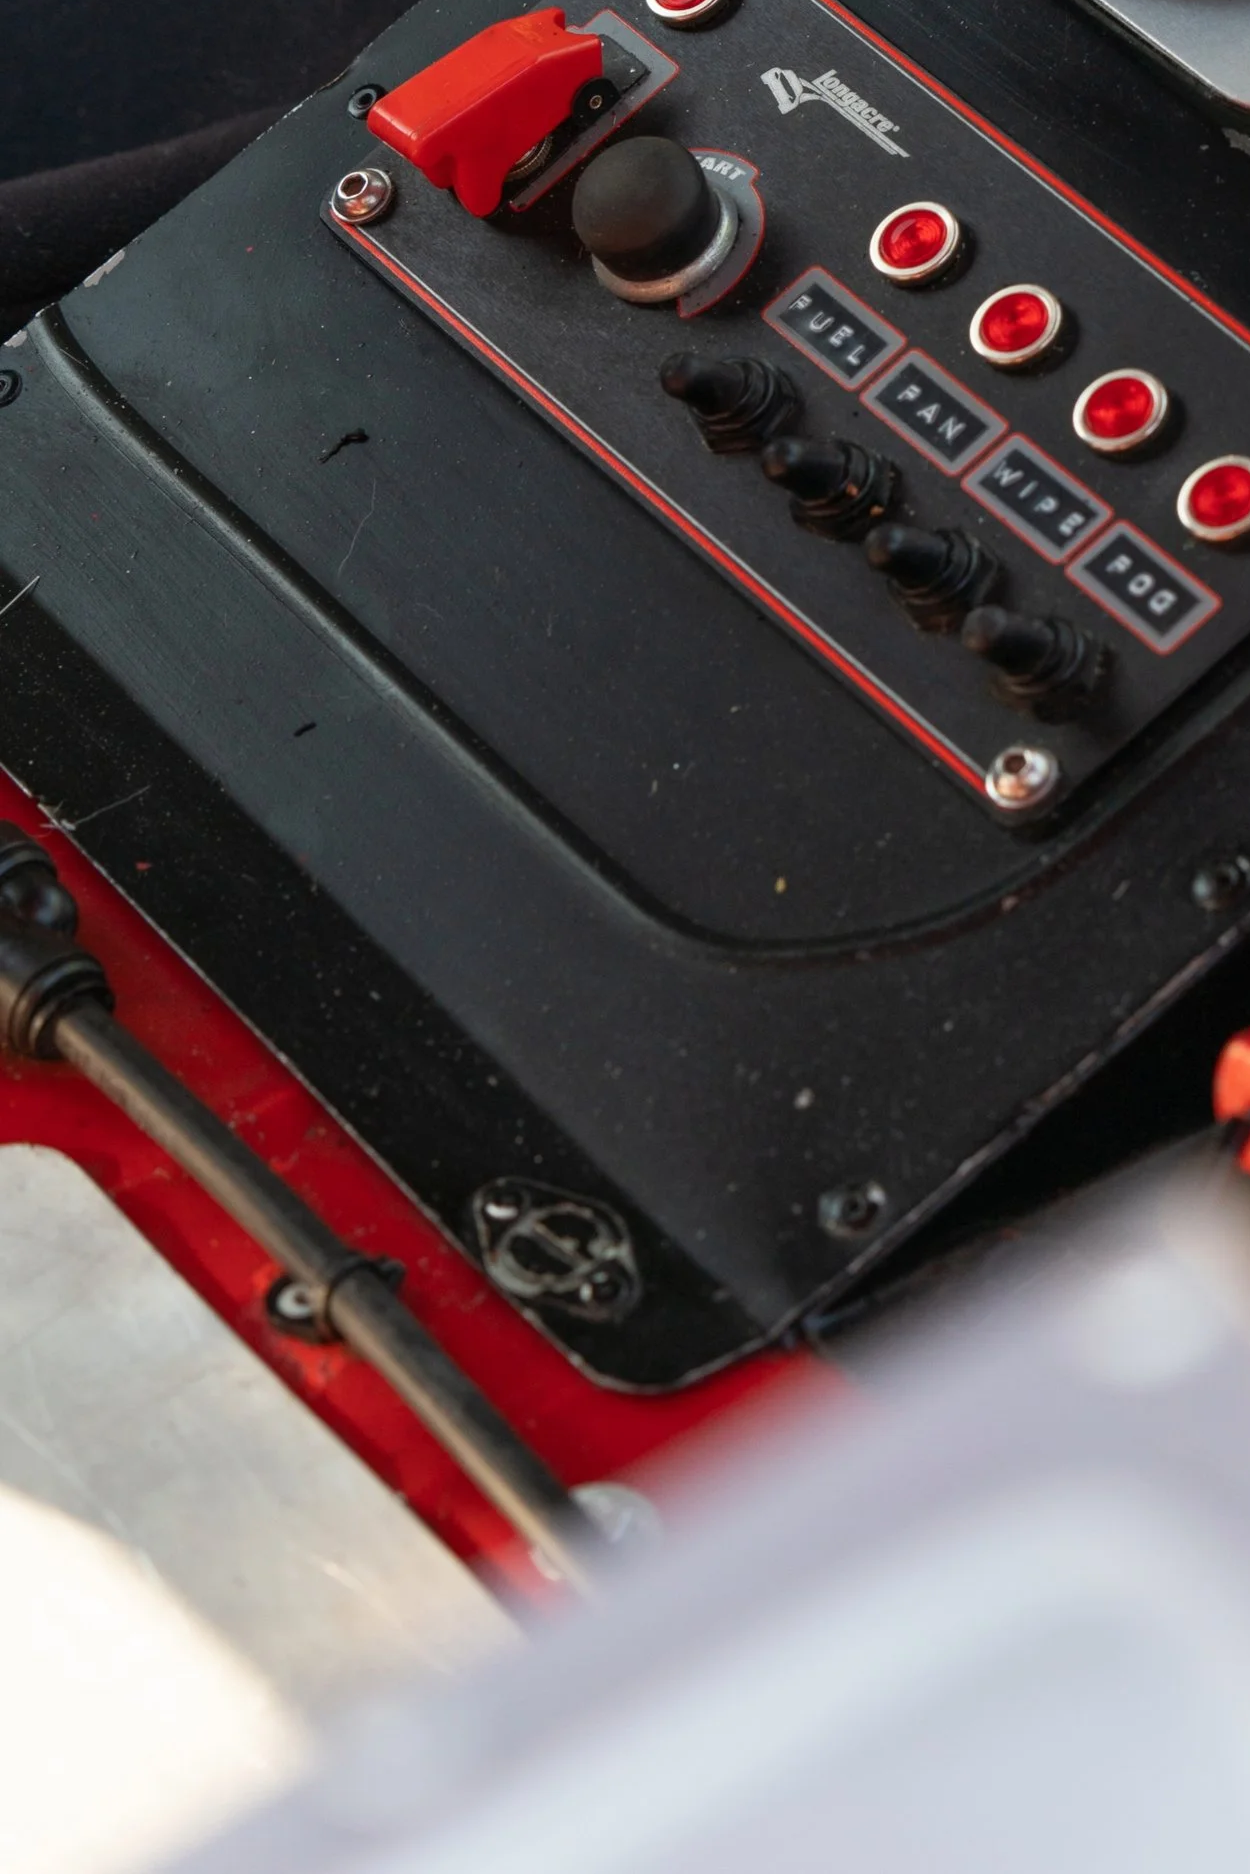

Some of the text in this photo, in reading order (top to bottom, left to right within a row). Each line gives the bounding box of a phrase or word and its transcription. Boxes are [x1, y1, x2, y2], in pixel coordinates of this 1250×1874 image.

[811, 69, 897, 133] Longacre
[695, 156, 747, 181] ART
[788, 294, 866, 366] FUEL
[897, 383, 967, 446] FAN
[993, 460, 1086, 537] WIPE
[1105, 554, 1178, 617] FOG
